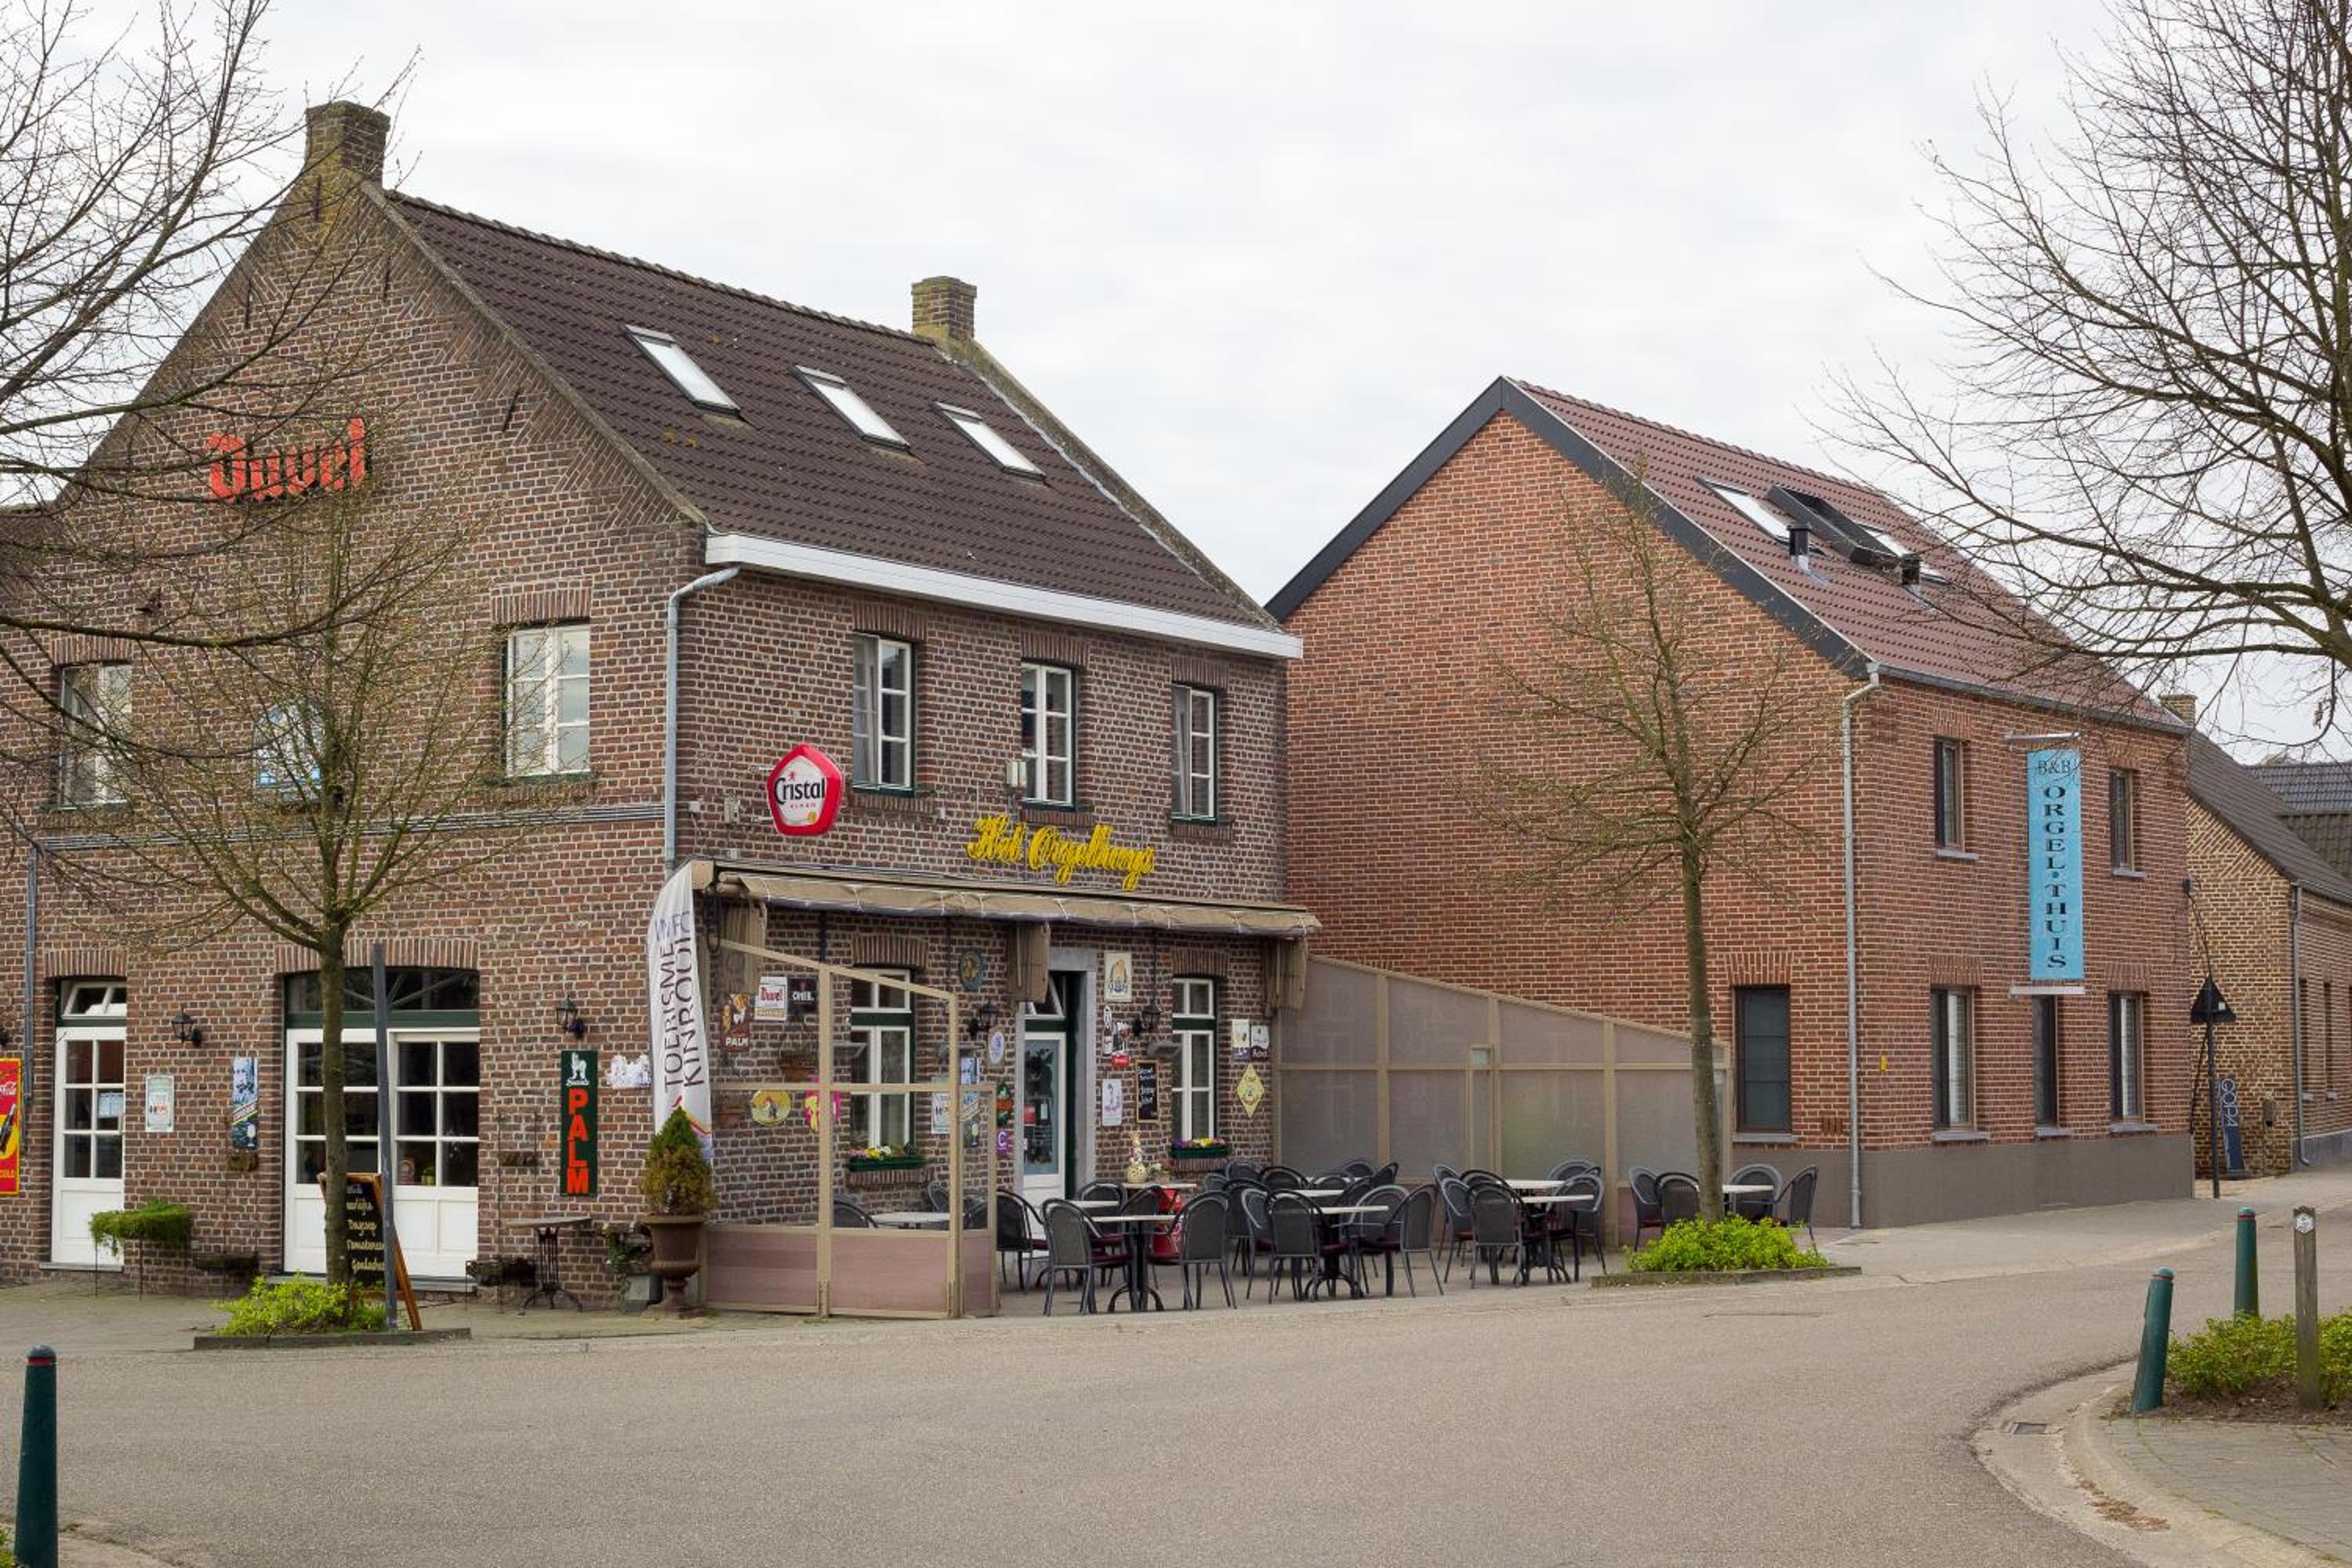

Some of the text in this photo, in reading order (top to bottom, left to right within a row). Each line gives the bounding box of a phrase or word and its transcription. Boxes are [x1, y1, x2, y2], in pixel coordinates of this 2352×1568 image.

[207, 416, 366, 504] Duvel
[2038, 759, 2071, 775] B&B
[775, 778, 825, 805] Cristal
[966, 815, 1026, 862] Het
[659, 942, 684, 1093] TOERISME
[725, 1037, 750, 1046] PALM
[567, 1087, 590, 1195] PALM
